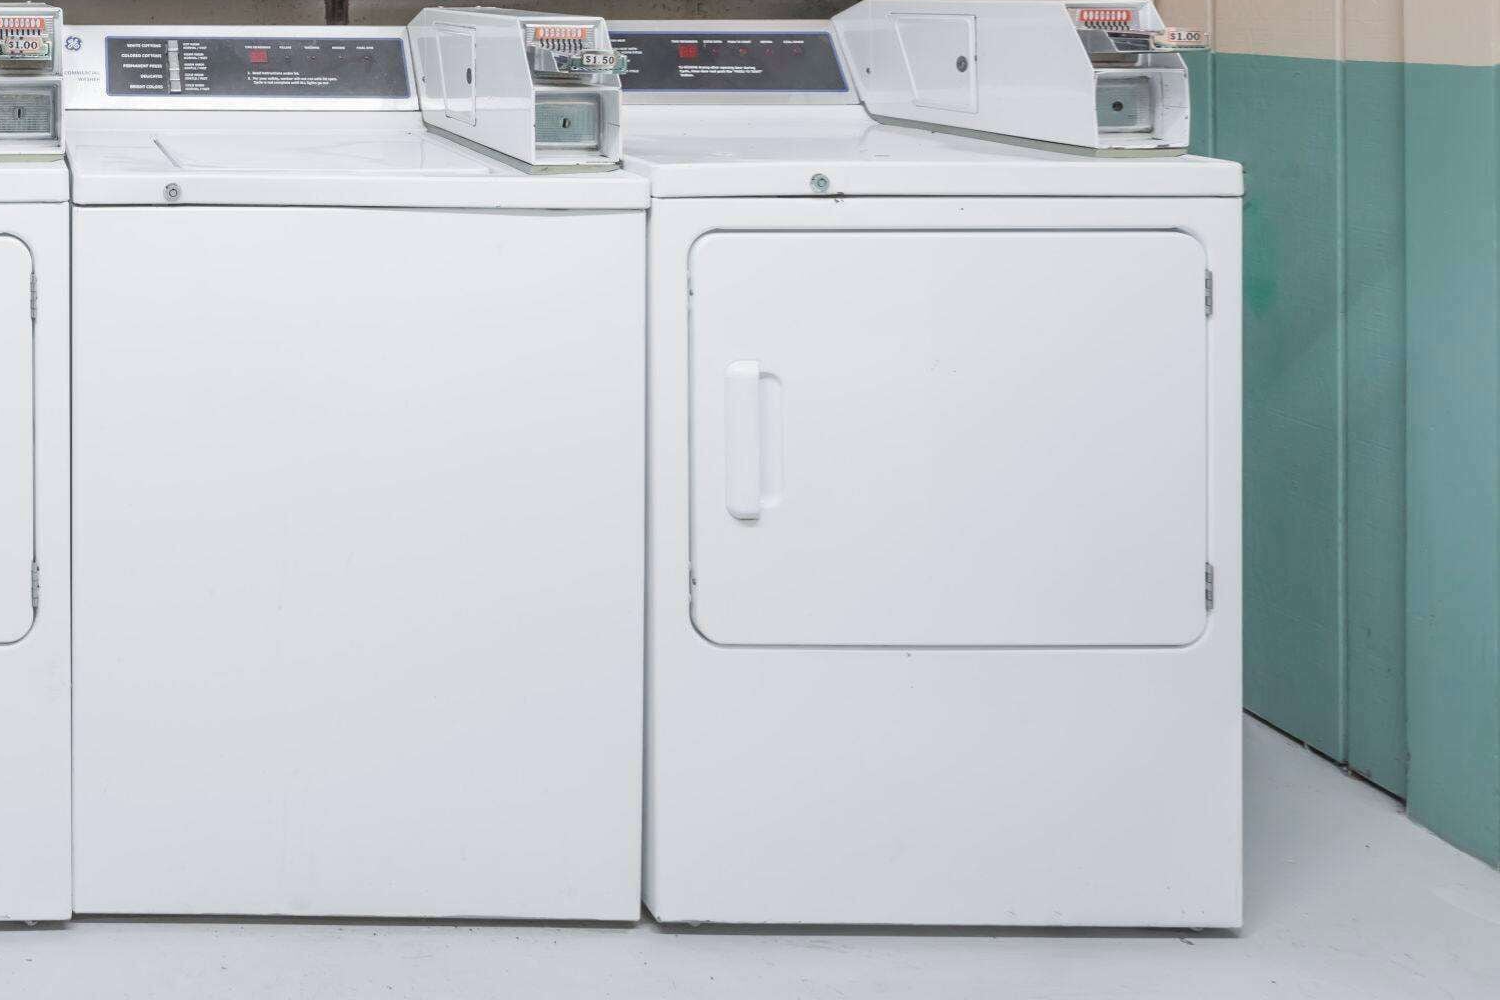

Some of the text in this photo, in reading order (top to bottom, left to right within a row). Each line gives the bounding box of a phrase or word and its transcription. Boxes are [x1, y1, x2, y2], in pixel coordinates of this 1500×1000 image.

[1170, 32, 1201, 41] $1.00
[8, 41, 38, 50] $1.00
[585, 55, 615, 65] $1.50
